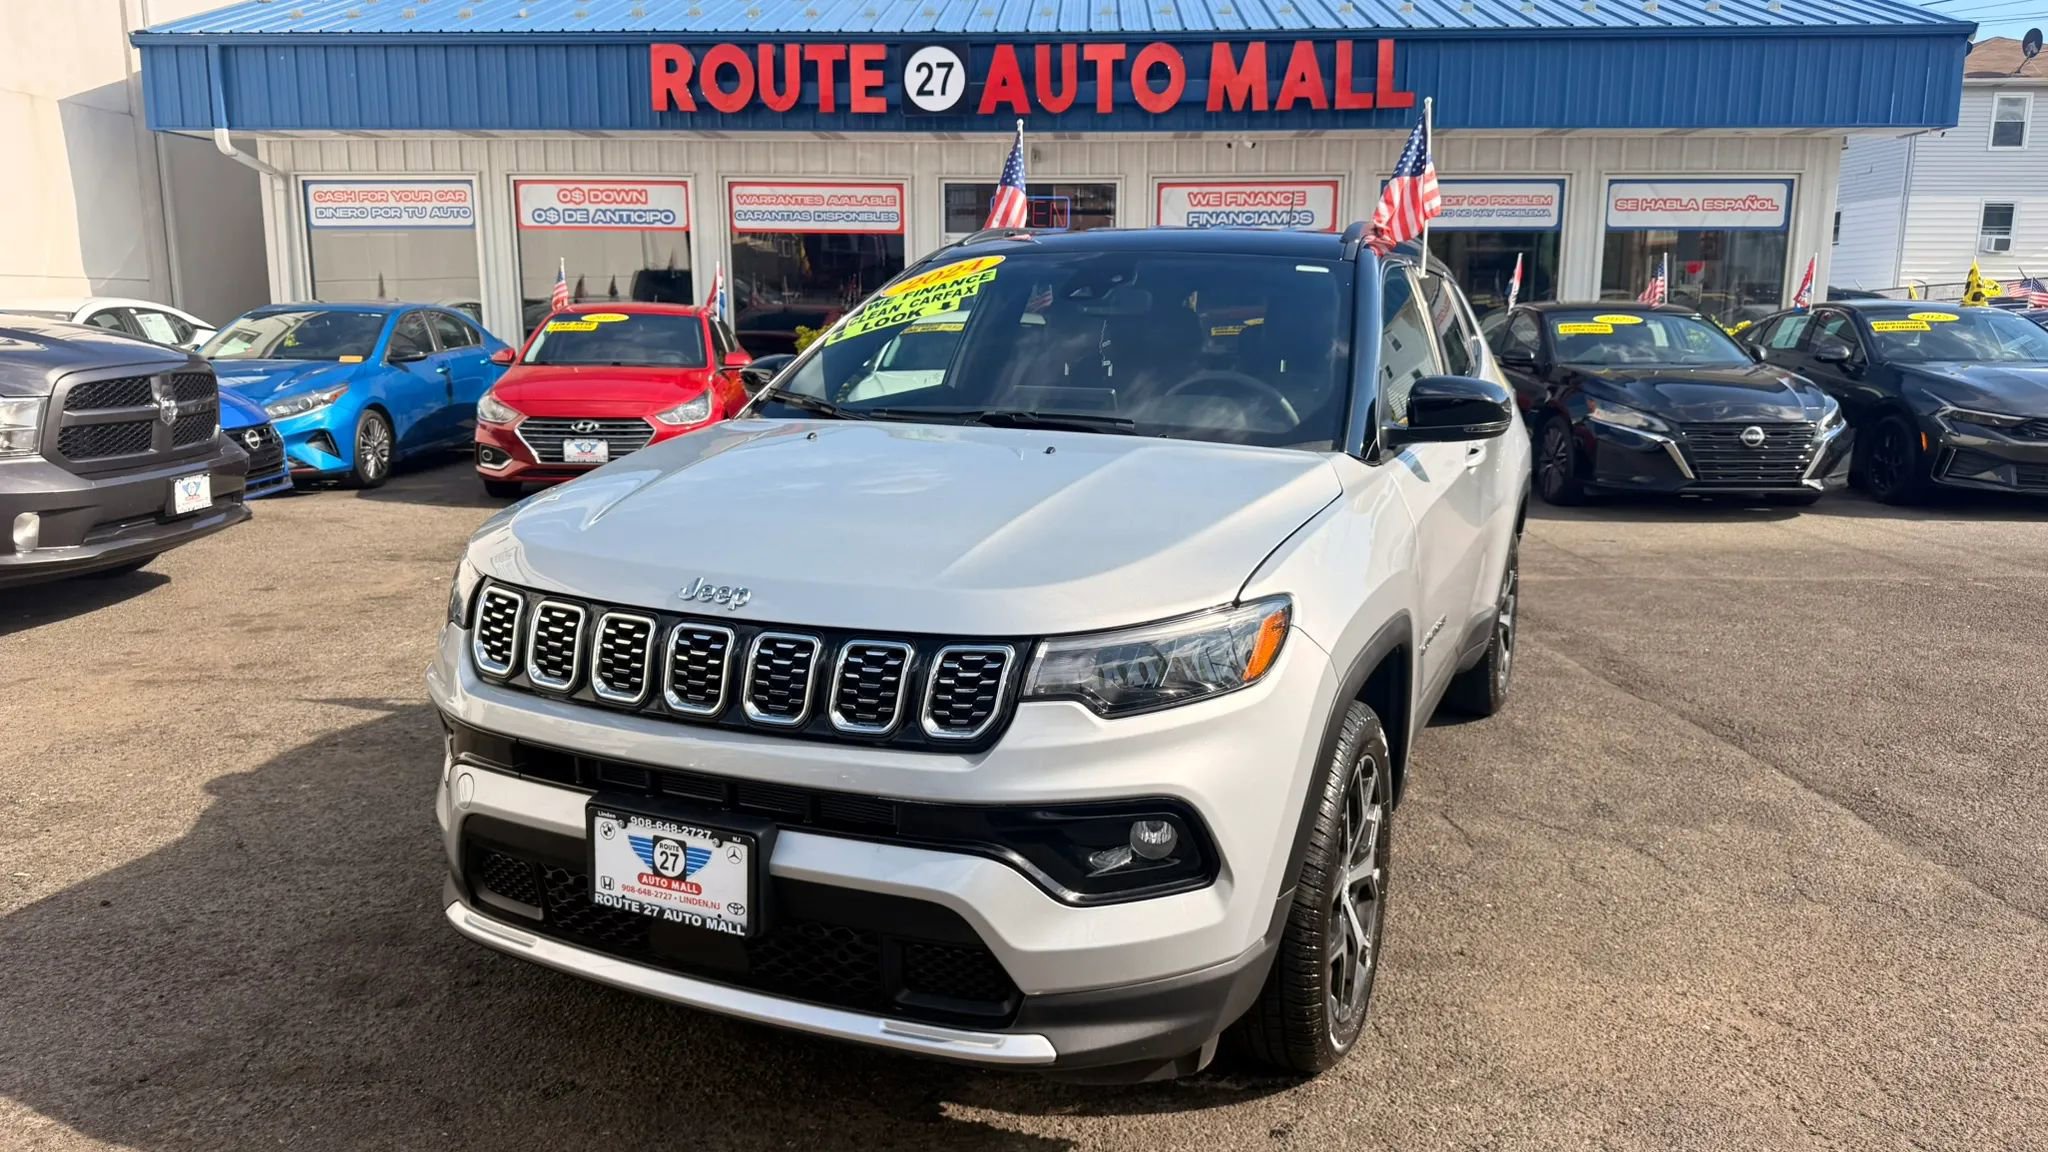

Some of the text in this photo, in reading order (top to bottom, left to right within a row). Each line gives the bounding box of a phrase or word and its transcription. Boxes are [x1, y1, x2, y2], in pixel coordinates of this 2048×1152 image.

[652, 38, 1415, 115] ROUTE 27 AUTO MALL
[314, 190, 467, 202] CASH FOR YOUR CAR
[588, 188, 648, 205] DOWN
[736, 194, 897, 207] WARRANTIES AVAILABLE
[1187, 190, 1307, 207] WE FINANCE
[1440, 195, 1553, 206] EDIT NO PROBLEM
[1615, 194, 1779, 212] SE HABLA ESPAÑOL
[315, 207, 472, 219] DINERO POR TU AUTO
[563, 208, 590, 223] DE
[591, 208, 676, 225] ANTICIPO
[735, 209, 899, 222] GARANTIAS DISPONIBLES
[1186, 210, 1315, 226] FINANCIAMOS
[1456, 208, 1472, 217] NO
[1472, 208, 1495, 217] HAY
[1496, 208, 1552, 217] PROBLEMA
[903, 259, 985, 291] 2024
[867, 271, 995, 311] WE FINANCE
[849, 285, 976, 326] CLEAN CARFAX
[860, 307, 926, 332] LOOK
[678, 577, 752, 611] Jeep
[597, 810, 617, 819] Linden
[630, 815, 713, 841] 908-648-2727
[659, 842, 680, 853] ROUTE
[731, 836, 742, 844] NJ
[659, 850, 680, 873] 27
[641, 874, 700, 894] AUTO MALL
[621, 883, 721, 911] 908-648-2727 LINDEN,NJ
[594, 892, 746, 937] ROUTE 27 AUTO MALL
